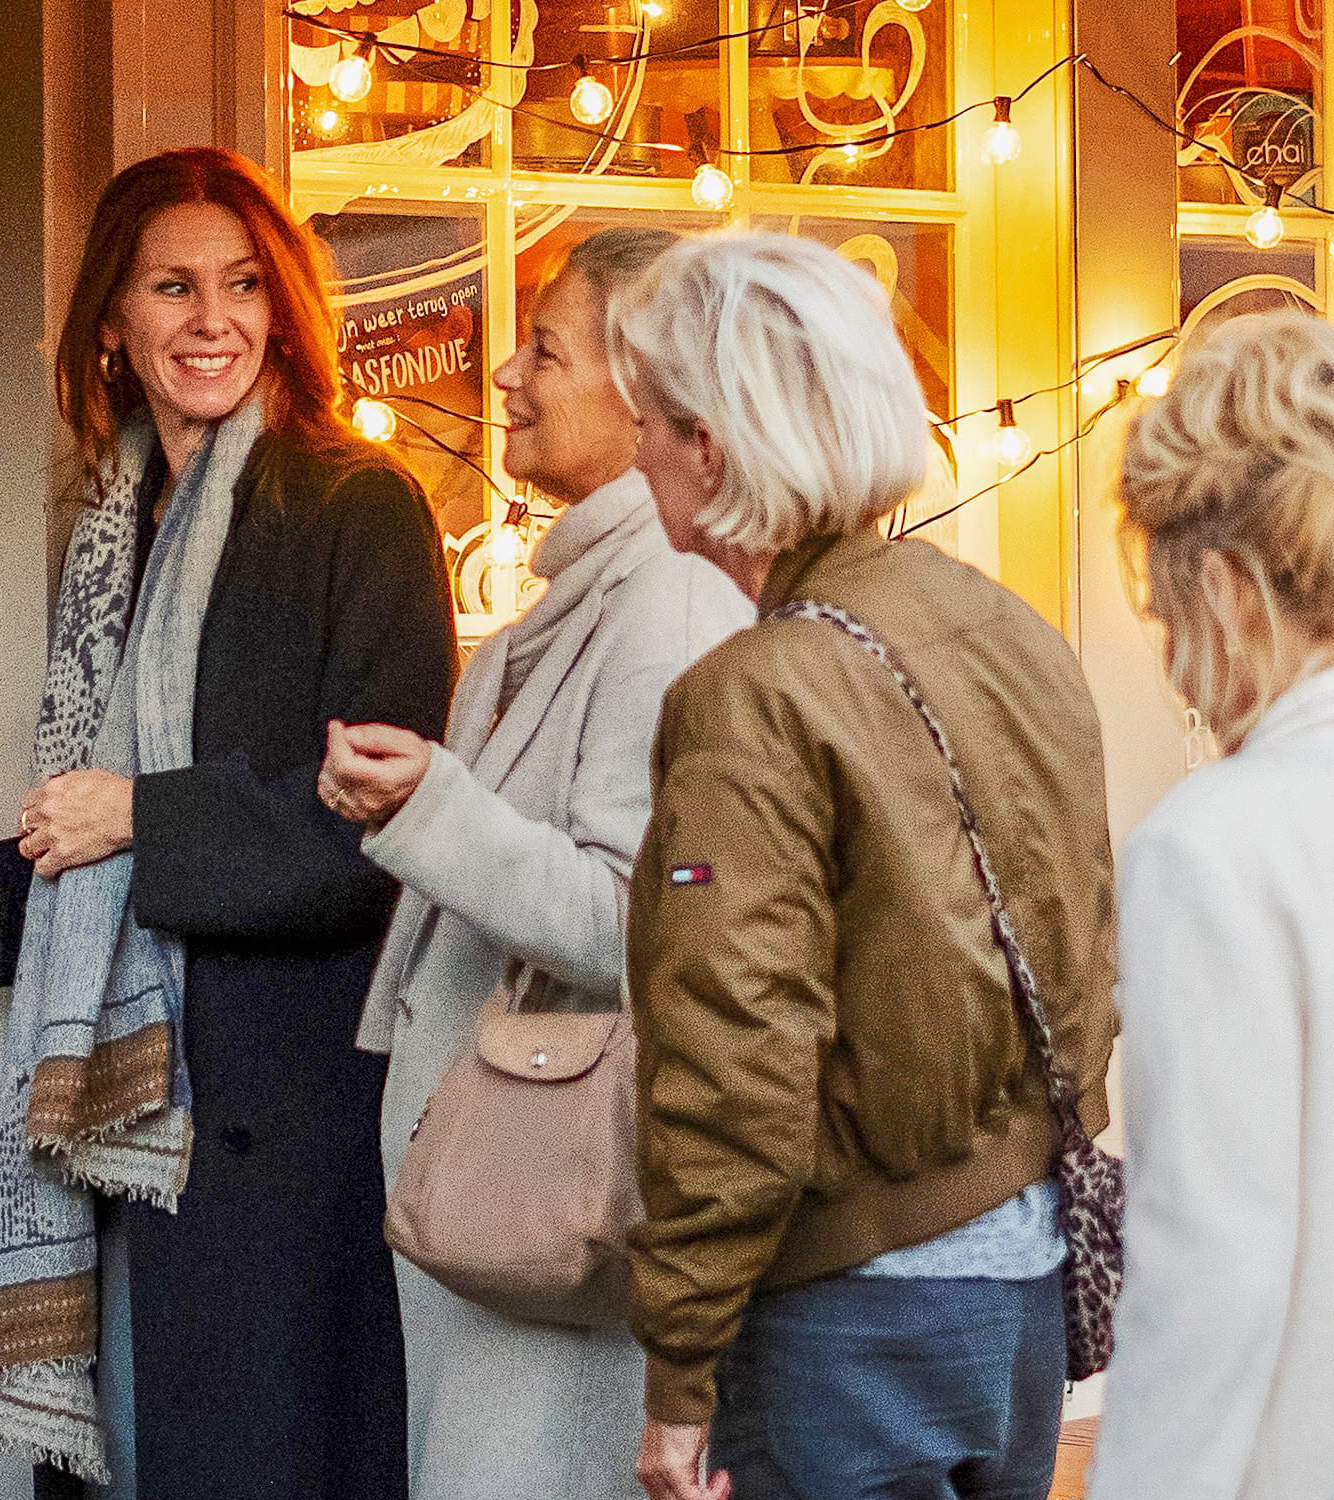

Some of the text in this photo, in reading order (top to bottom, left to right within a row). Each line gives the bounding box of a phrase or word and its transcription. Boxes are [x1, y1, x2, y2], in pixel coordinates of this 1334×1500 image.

[363, 307, 404, 334] weer
[407, 297, 449, 317] terug
[451, 284, 479, 307] open
